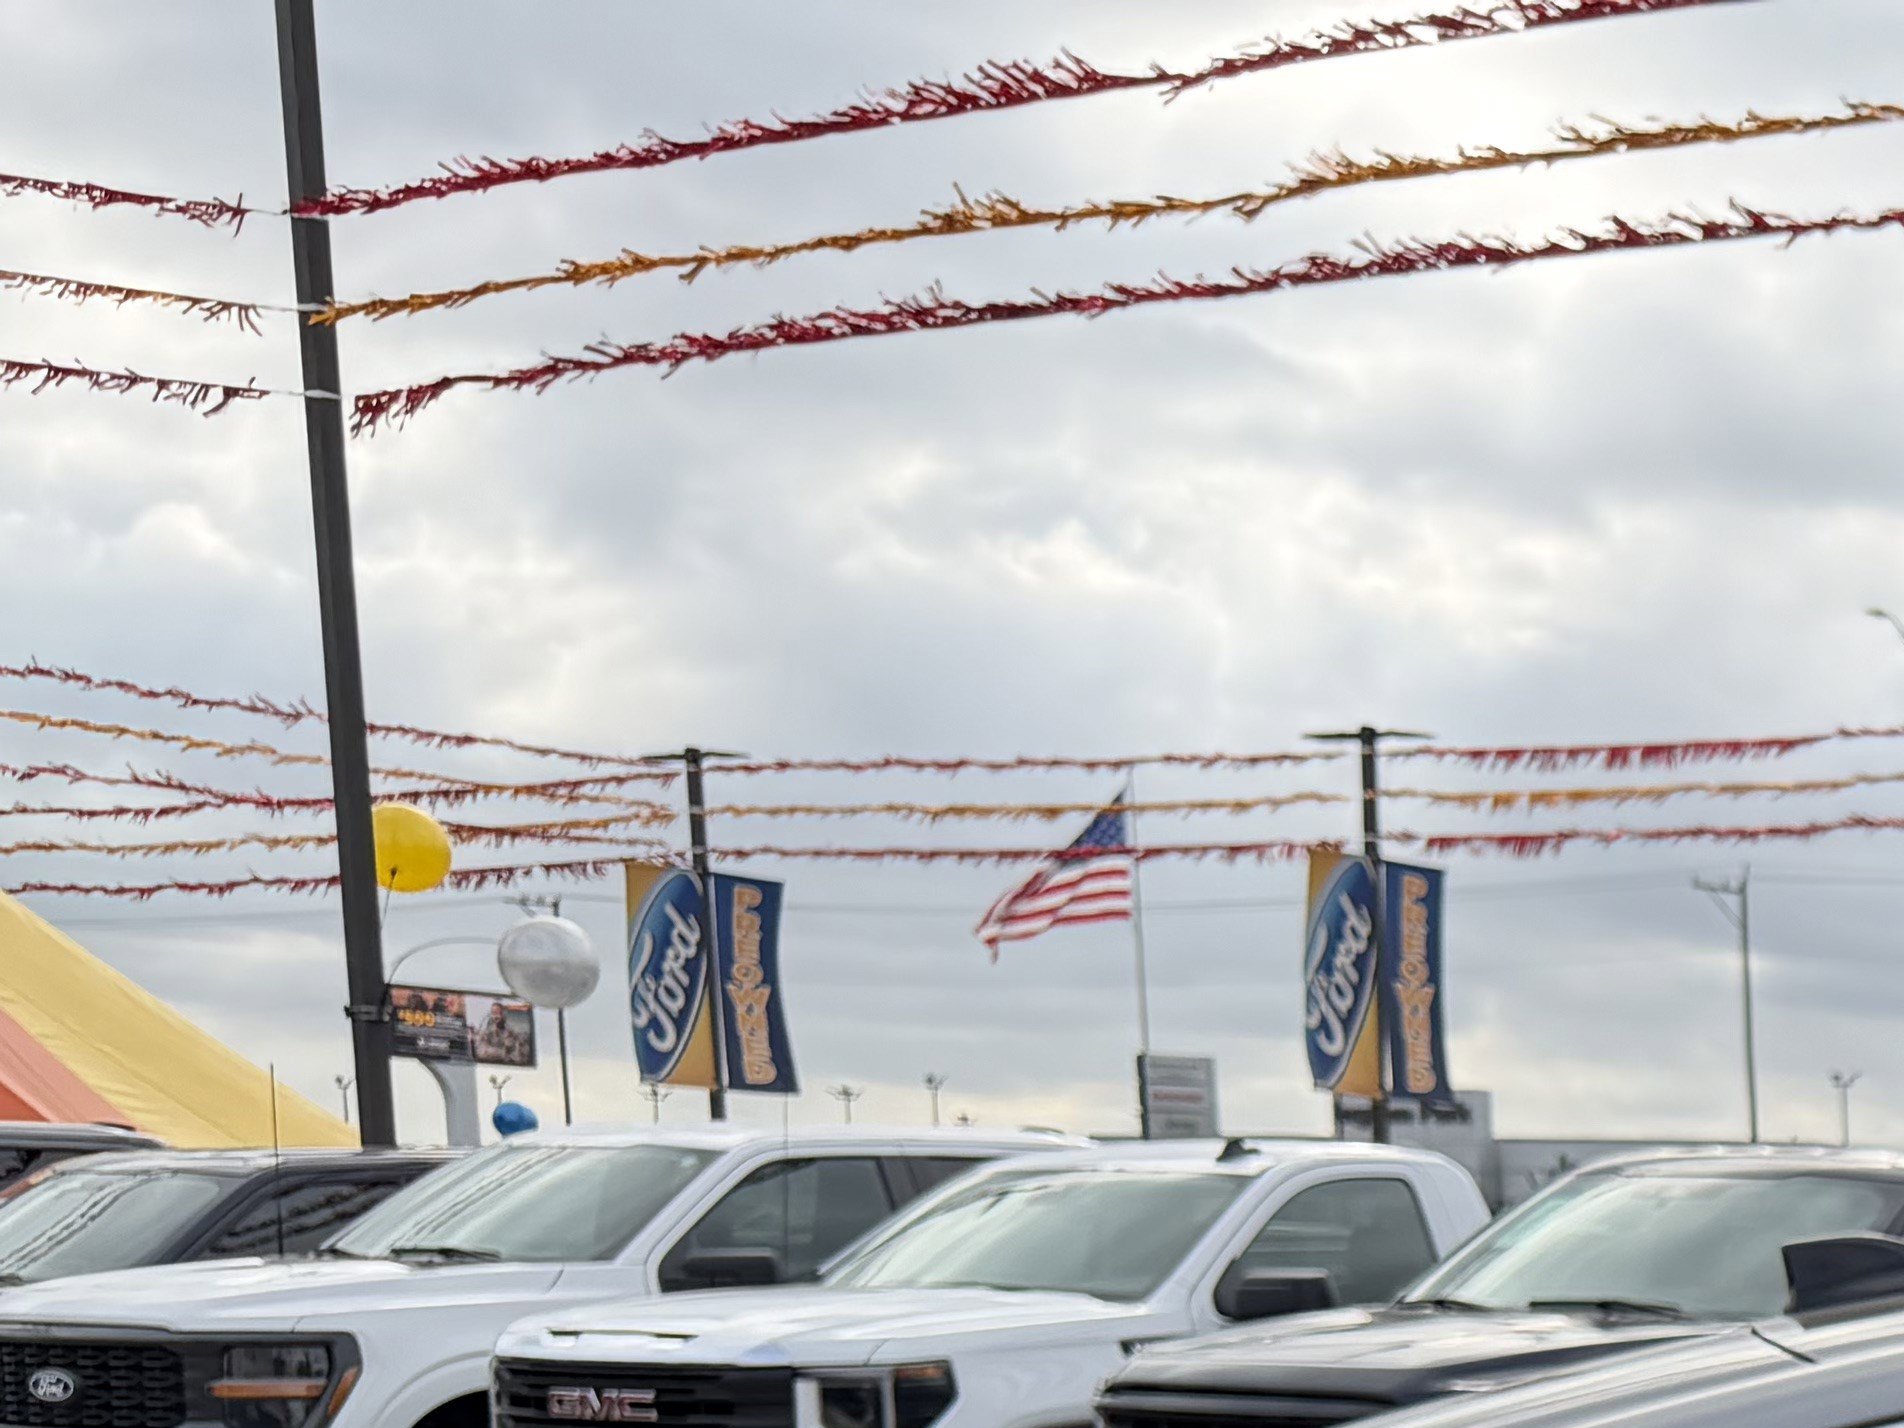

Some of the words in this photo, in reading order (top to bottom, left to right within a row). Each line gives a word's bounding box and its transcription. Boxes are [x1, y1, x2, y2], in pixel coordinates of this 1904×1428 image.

[630, 901, 702, 1053] Ford
[1305, 889, 1373, 1057] Ford
[547, 1386, 659, 1423] GMC
